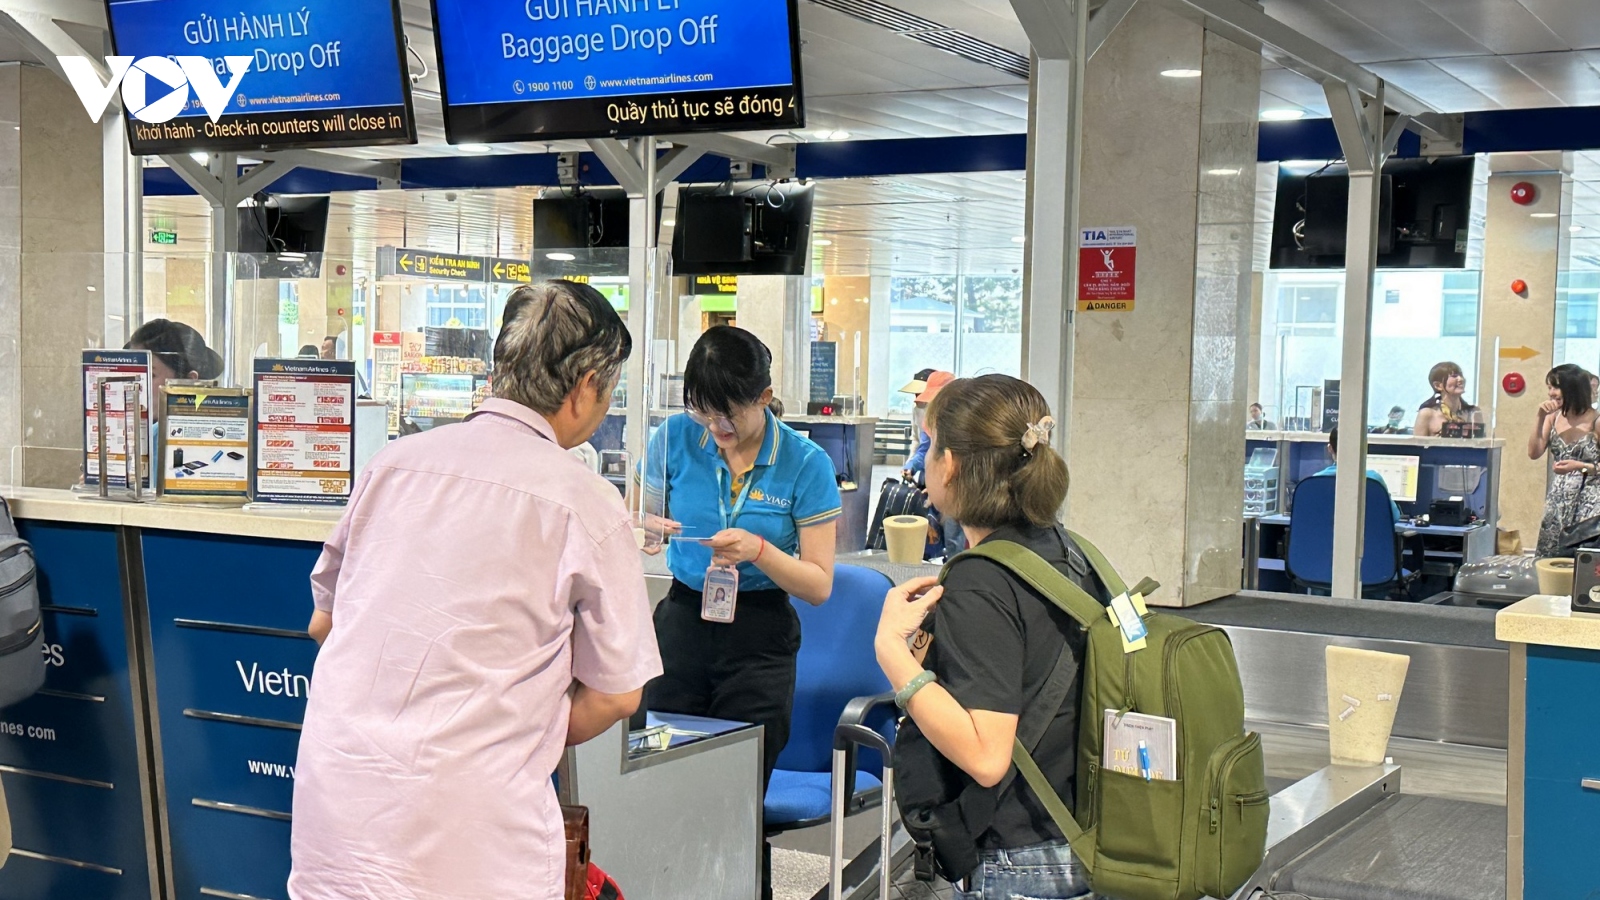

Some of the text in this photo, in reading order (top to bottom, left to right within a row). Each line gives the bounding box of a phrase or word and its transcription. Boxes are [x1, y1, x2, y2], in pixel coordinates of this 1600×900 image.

[183, 6, 311, 44] GỬI HÀNH LÝ
[501, 14, 719, 64] Baggage Drop Off
[254, 48, 304, 76] Drop
[309, 41, 341, 69] Off
[527, 73, 713, 92] 1900 1100 www.vietnamairlines.com
[249, 92, 341, 105] www.vietnamairlines.com
[607, 100, 648, 124] Quầy
[651, 98, 679, 119] thủ
[682, 101, 709, 122] tục
[714, 96, 735, 116] sẽ
[739, 93, 783, 117] đóng
[135, 121, 162, 141] khởi
[164, 122, 194, 140] hành
[204, 119, 259, 138] Check-in
[262, 117, 320, 135] counters
[322, 114, 346, 132] will
[349, 112, 386, 130] close
[389, 113, 401, 129] in
[1082, 230, 1106, 240] TIA
[1094, 302, 1127, 310] DANGER
